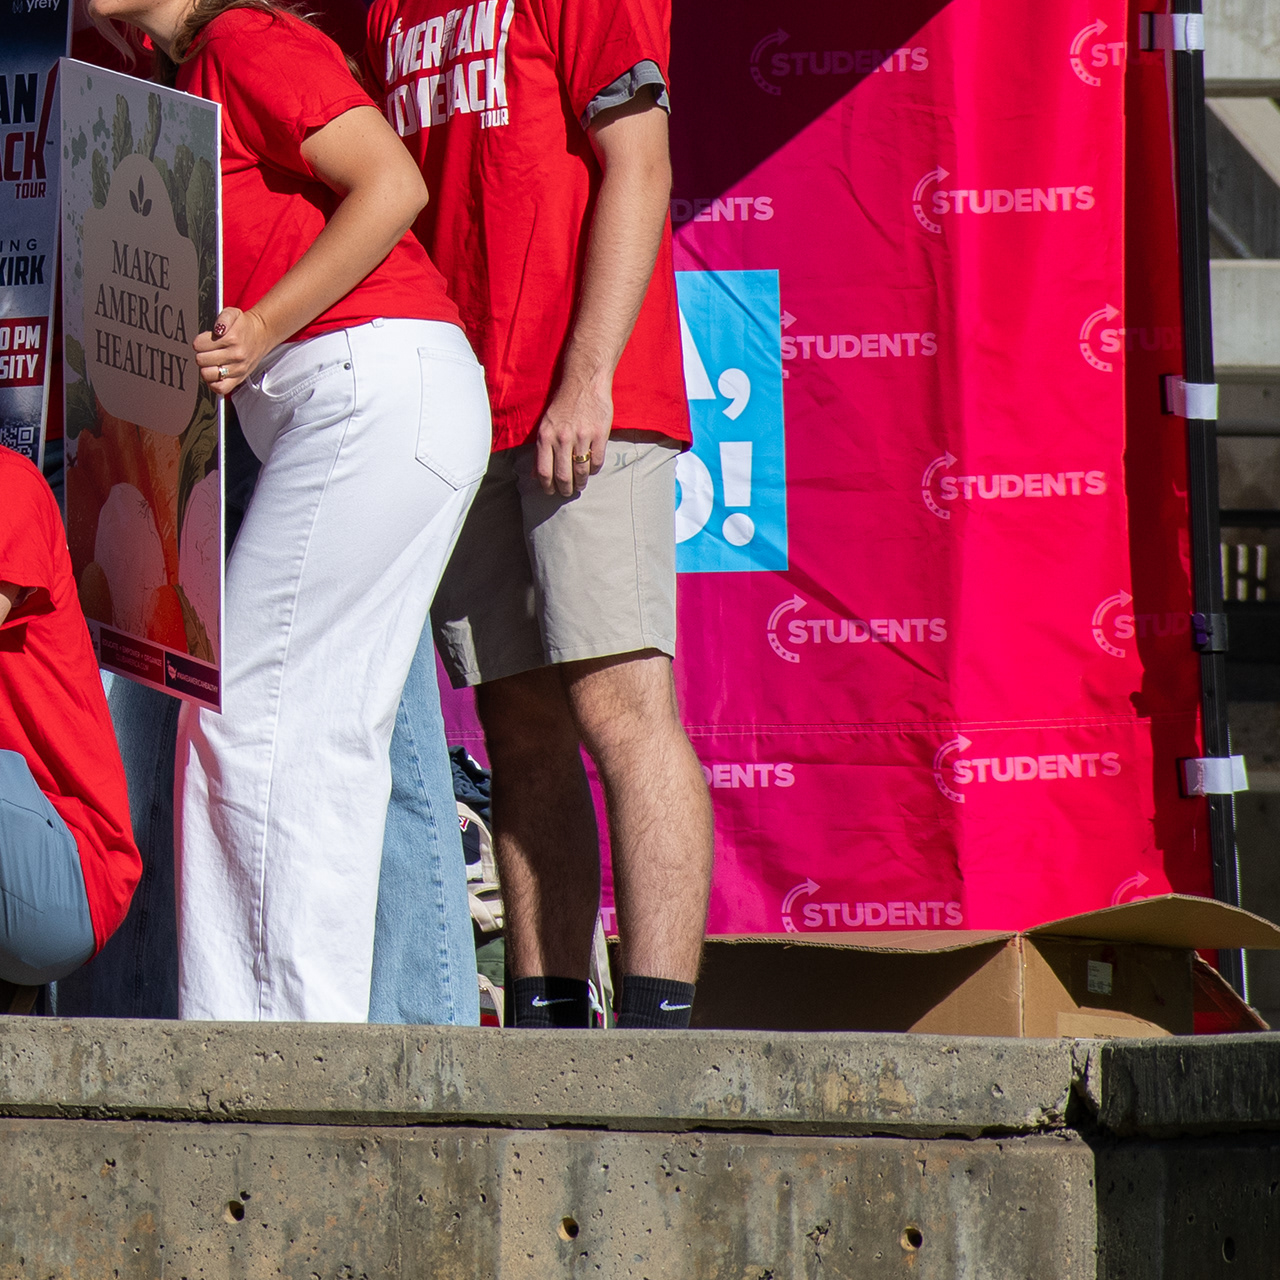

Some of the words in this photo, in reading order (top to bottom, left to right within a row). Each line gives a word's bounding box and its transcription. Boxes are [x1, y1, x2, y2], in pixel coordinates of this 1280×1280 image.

[771, 46, 930, 76] STUDENTS
[480, 108, 510, 129] TOUR
[14, 182, 47, 200] TOUR
[931, 184, 1096, 215] STUDENTS
[670, 196, 775, 222] DENTS
[111, 239, 171, 292] MAKE
[13, 325, 41, 351] PM
[781, 332, 938, 361] STUDENTS
[95, 328, 189, 392] HEALTHY
[940, 470, 1107, 502] STUDENTS
[787, 618, 948, 646] STUDENTS
[953, 751, 1122, 786] STUDENTS
[802, 900, 964, 929] STUDENTS
